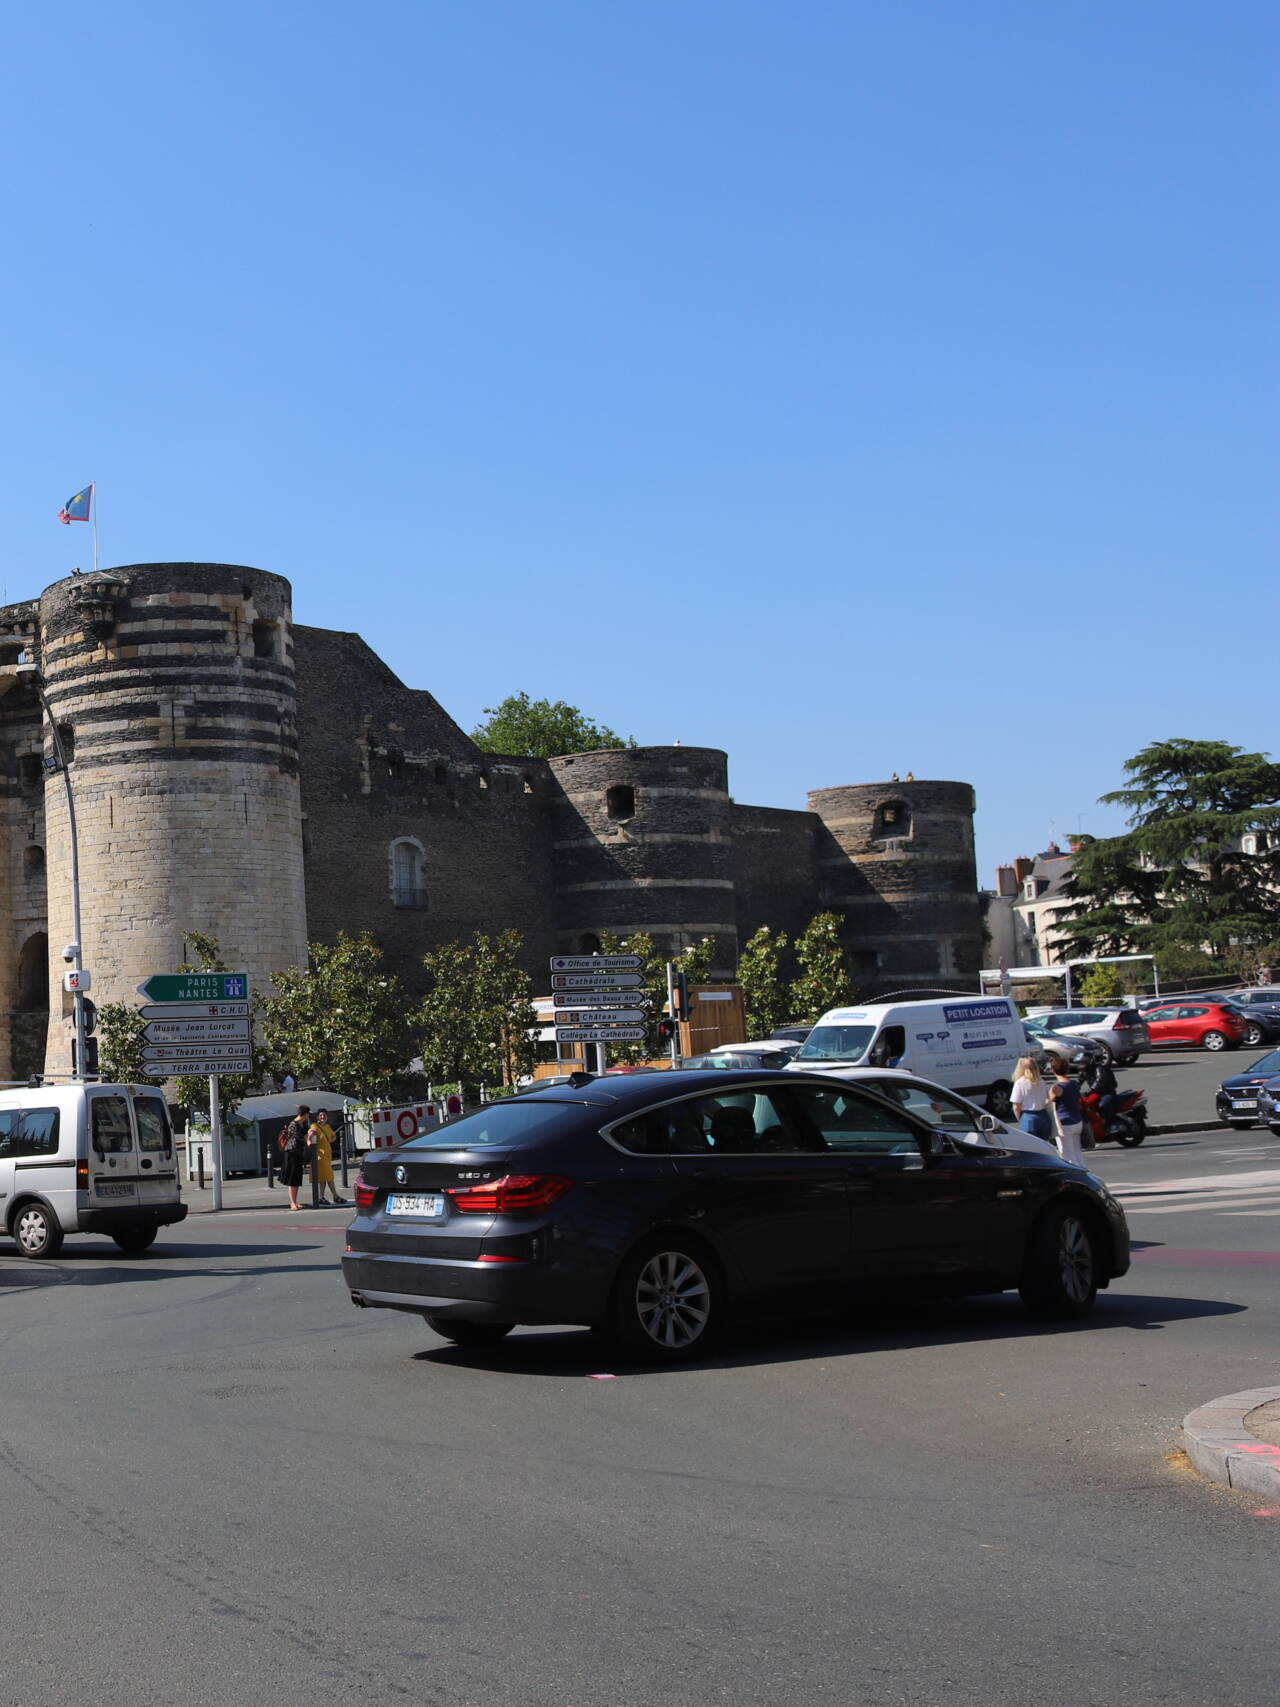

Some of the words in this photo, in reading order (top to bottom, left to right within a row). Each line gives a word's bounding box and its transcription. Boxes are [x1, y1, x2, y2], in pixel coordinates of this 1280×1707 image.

[187, 978, 218, 987] PARIS
[568, 977, 615, 985] Cathédrale
[179, 988, 219, 998] NANTES
[947, 1009, 969, 1019] PETIT
[970, 1005, 1008, 1017] LOCATION
[582, 1013, 617, 1021] Château
[153, 1024, 180, 1033] Musée
[186, 1024, 205, 1032] Jean
[600, 1030, 639, 1038] Cathédrale
[175, 1048, 207, 1056] Théâtre
[172, 1064, 200, 1072] TERRA
[204, 1062, 248, 1071] BOTANICA
